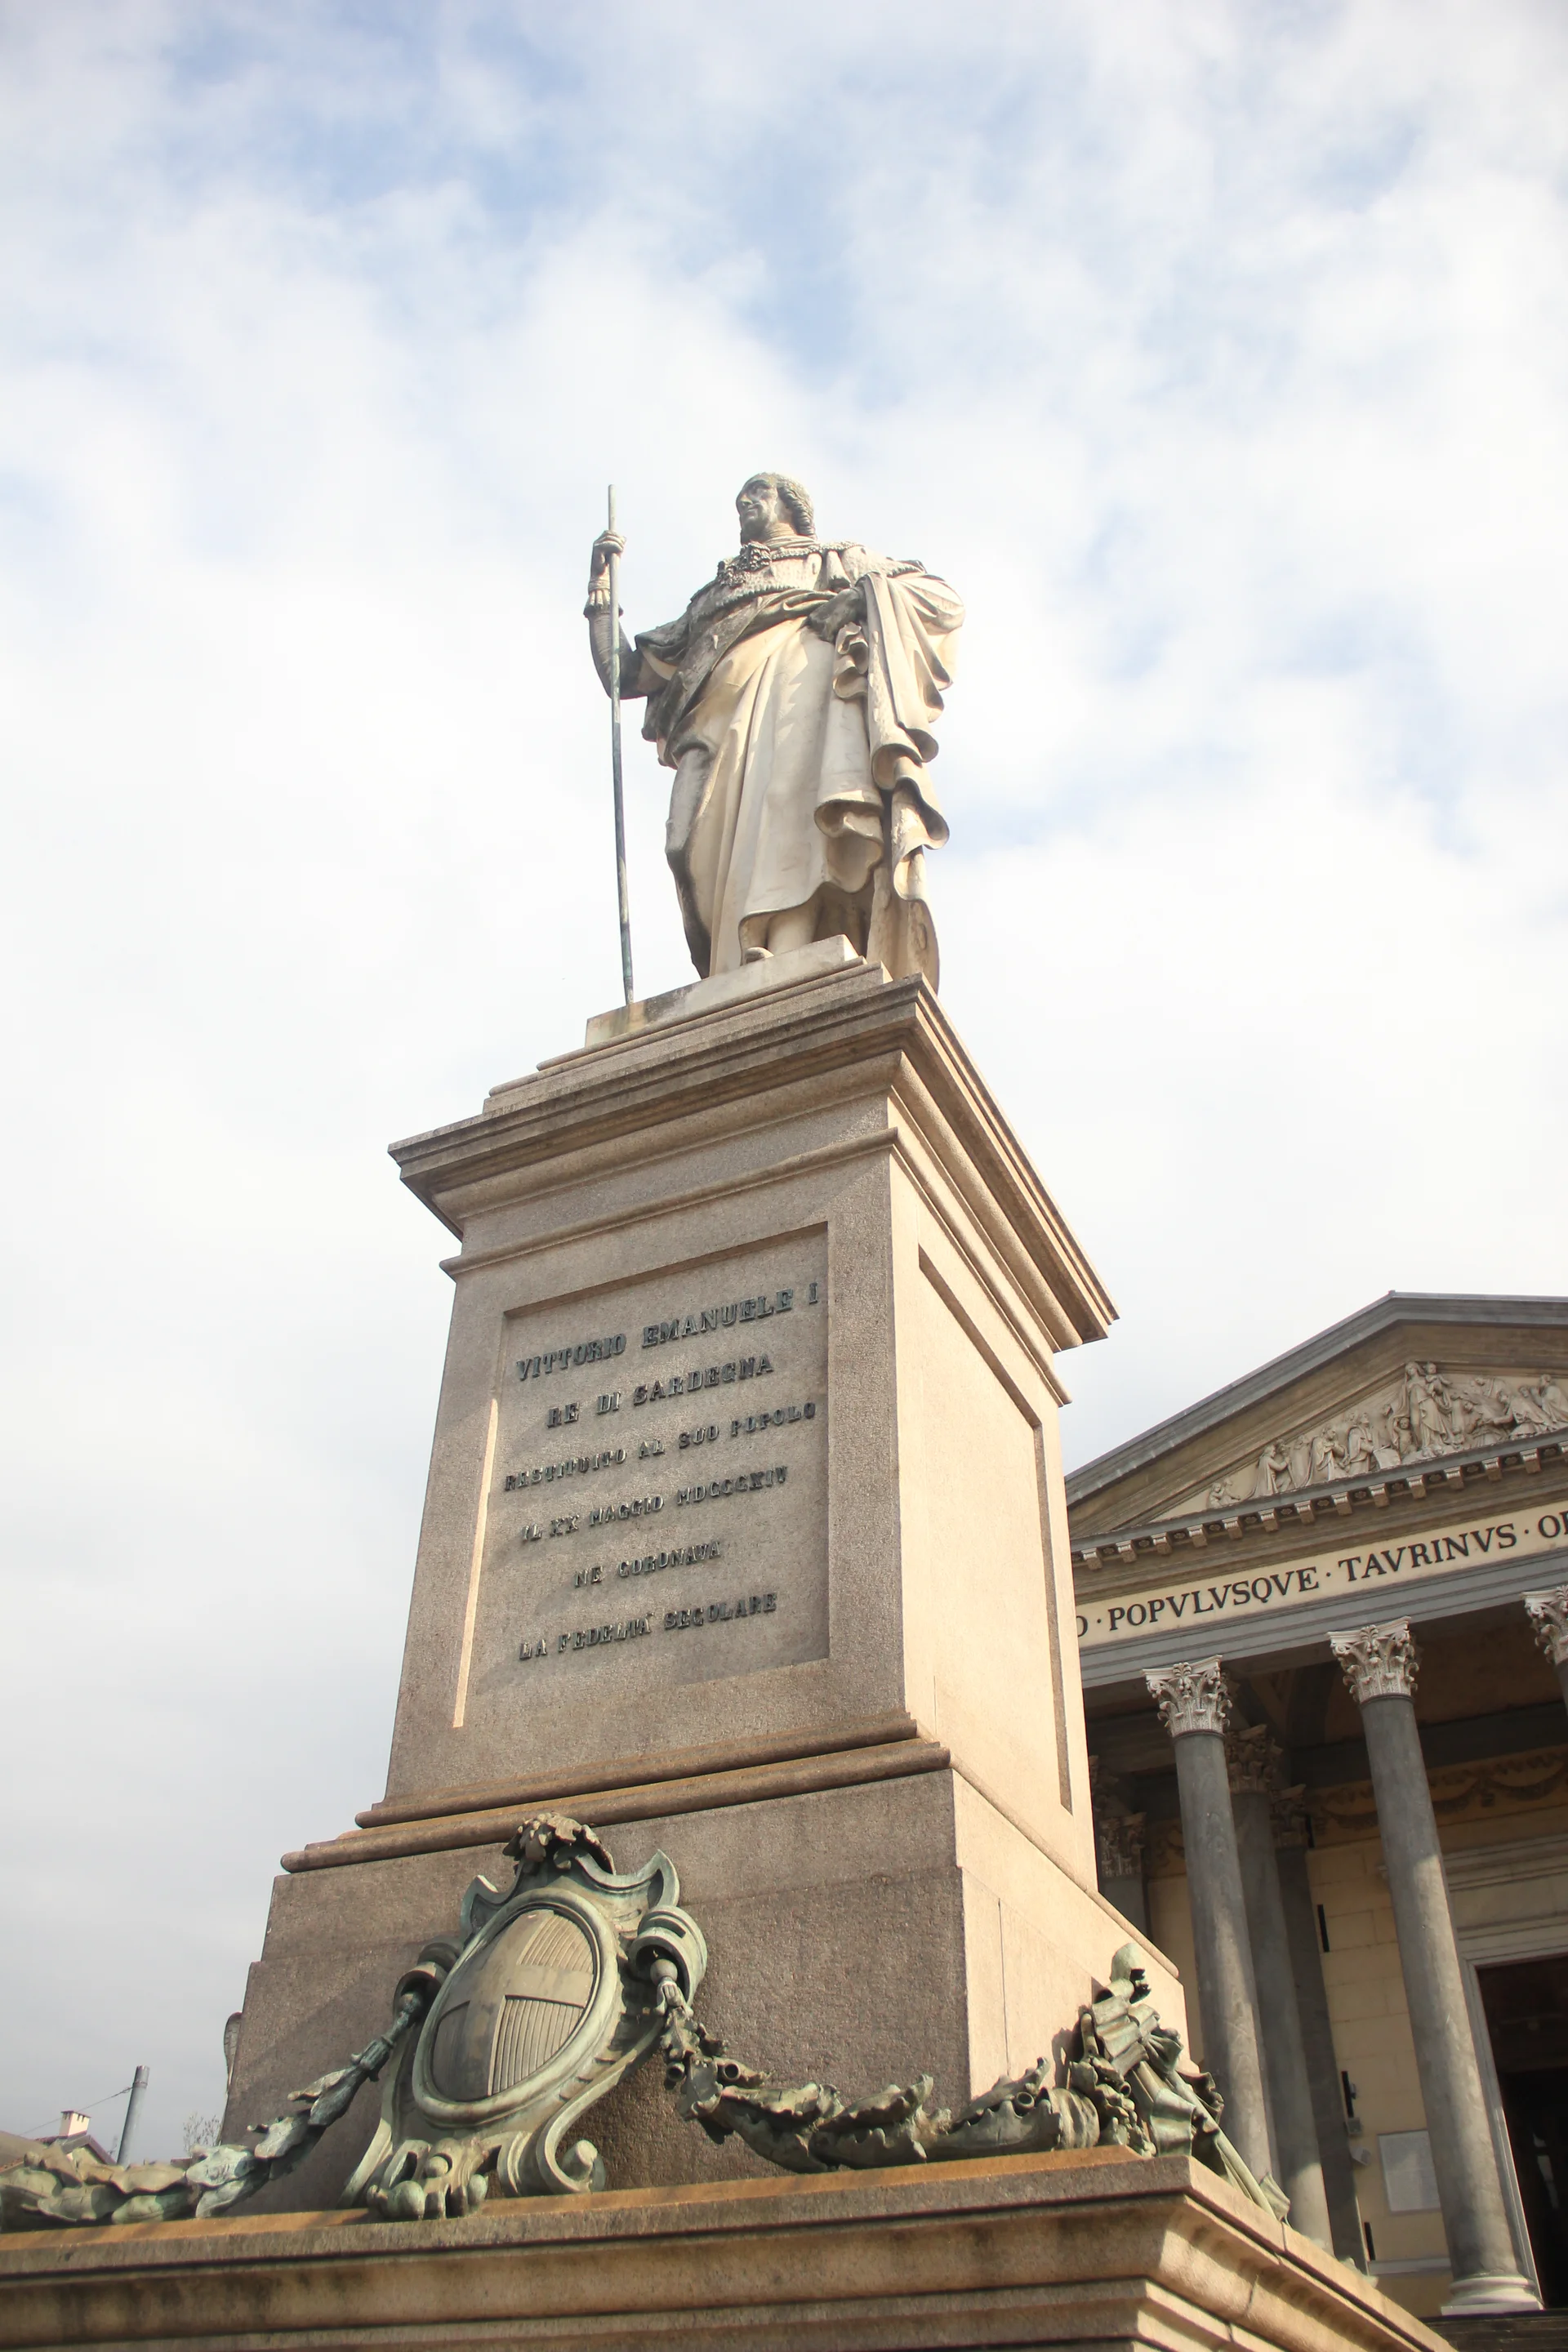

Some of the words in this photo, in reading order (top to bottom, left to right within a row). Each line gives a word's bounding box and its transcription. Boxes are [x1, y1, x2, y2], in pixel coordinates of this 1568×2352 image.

[516, 1333, 627, 1381] VITTORIO
[642, 1288, 794, 1348] EMANUELE
[808, 1282, 819, 1304] I
[546, 1402, 580, 1428] RE
[597, 1391, 621, 1414] DI
[633, 1352, 775, 1406] SARDEGNA
[504, 1448, 627, 1491] RESTITUITO
[638, 1438, 666, 1459] AL
[679, 1425, 719, 1449] SUO
[731, 1402, 816, 1437] POPOLO
[522, 1523, 542, 1542] IL
[549, 1514, 580, 1537] XX
[589, 1495, 665, 1526] MAGGIO
[676, 1465, 788, 1506] MDCCCXIV
[574, 1566, 604, 1588] NE
[617, 1540, 721, 1577] CORONAVA
[1107, 1566, 1320, 1632] POPVLVSQVE
[1338, 1522, 1517, 1582] TAVRINVS
[519, 1638, 548, 1660] LA
[664, 1592, 777, 1631] SECOLARE
